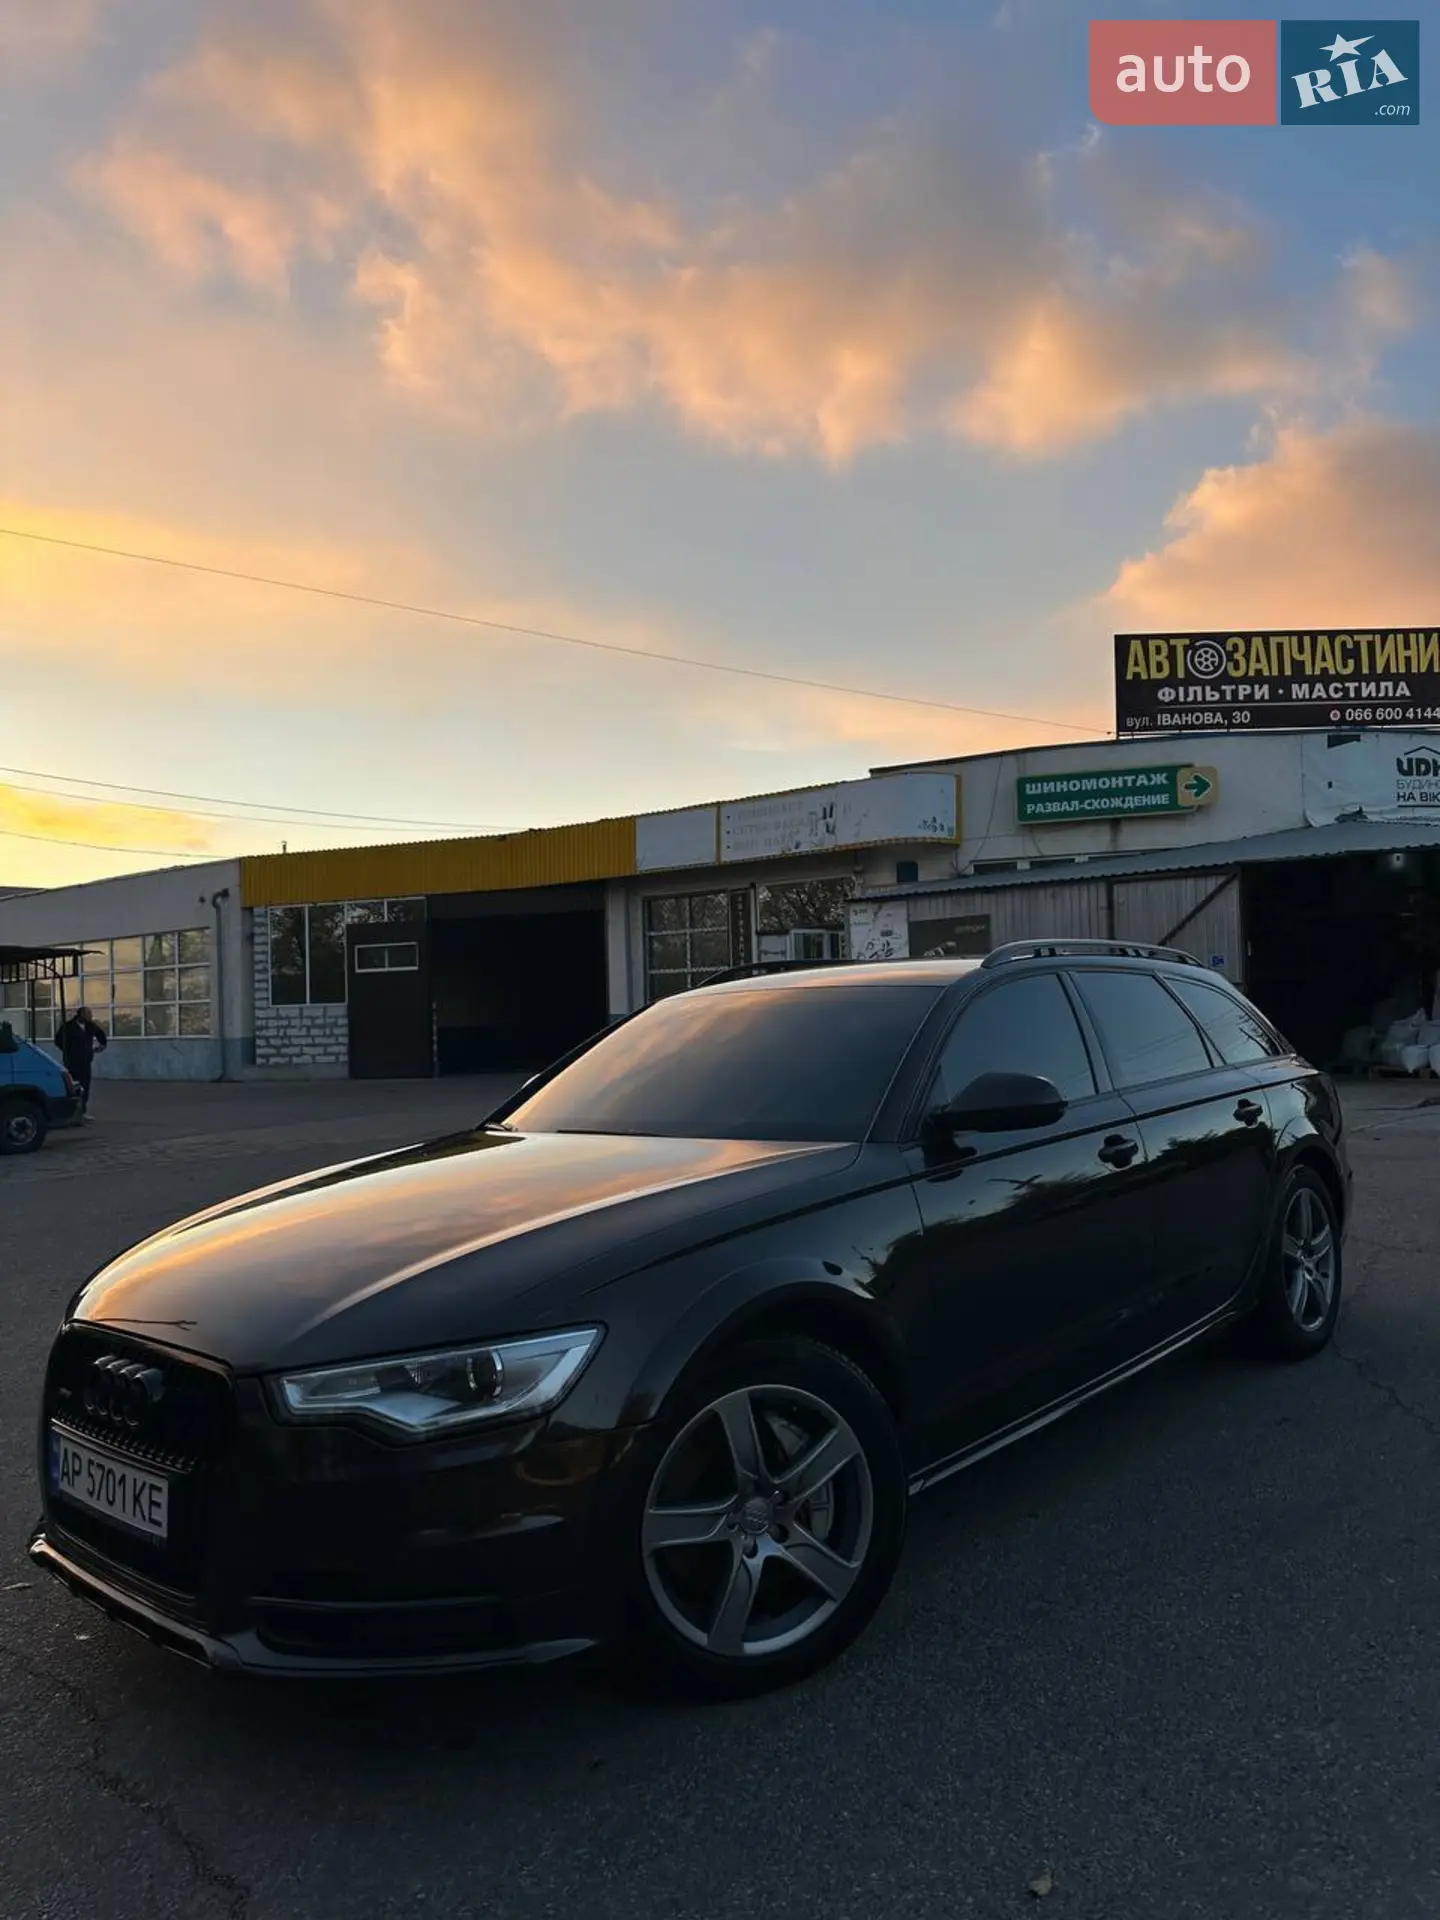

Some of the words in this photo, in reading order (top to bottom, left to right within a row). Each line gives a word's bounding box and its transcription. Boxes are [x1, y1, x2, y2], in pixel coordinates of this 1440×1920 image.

[1157, 683, 1270, 702] ФІЛЬТРИ
[1291, 680, 1411, 699] МАСТИЛА
[1126, 716, 1153, 729] вул.
[1157, 710, 1228, 726] ІВАНОВА,
[1231, 710, 1251, 724] 30
[1345, 708, 1373, 721] 066
[1376, 707, 1403, 720] 600
[1405, 707, 1440, 720] 4144
[1025, 772, 1169, 795] ШИНОМОНТАЖ
[1396, 779, 1440, 790] БУДИН
[1026, 793, 1170, 814] РАЗВАЛ-СХОЖДЕНИЕ
[1397, 791, 1417, 802] НА
[60, 1447, 83, 1488] AP
[86, 1458, 127, 1513] 5701
[132, 1477, 163, 1528] KE
